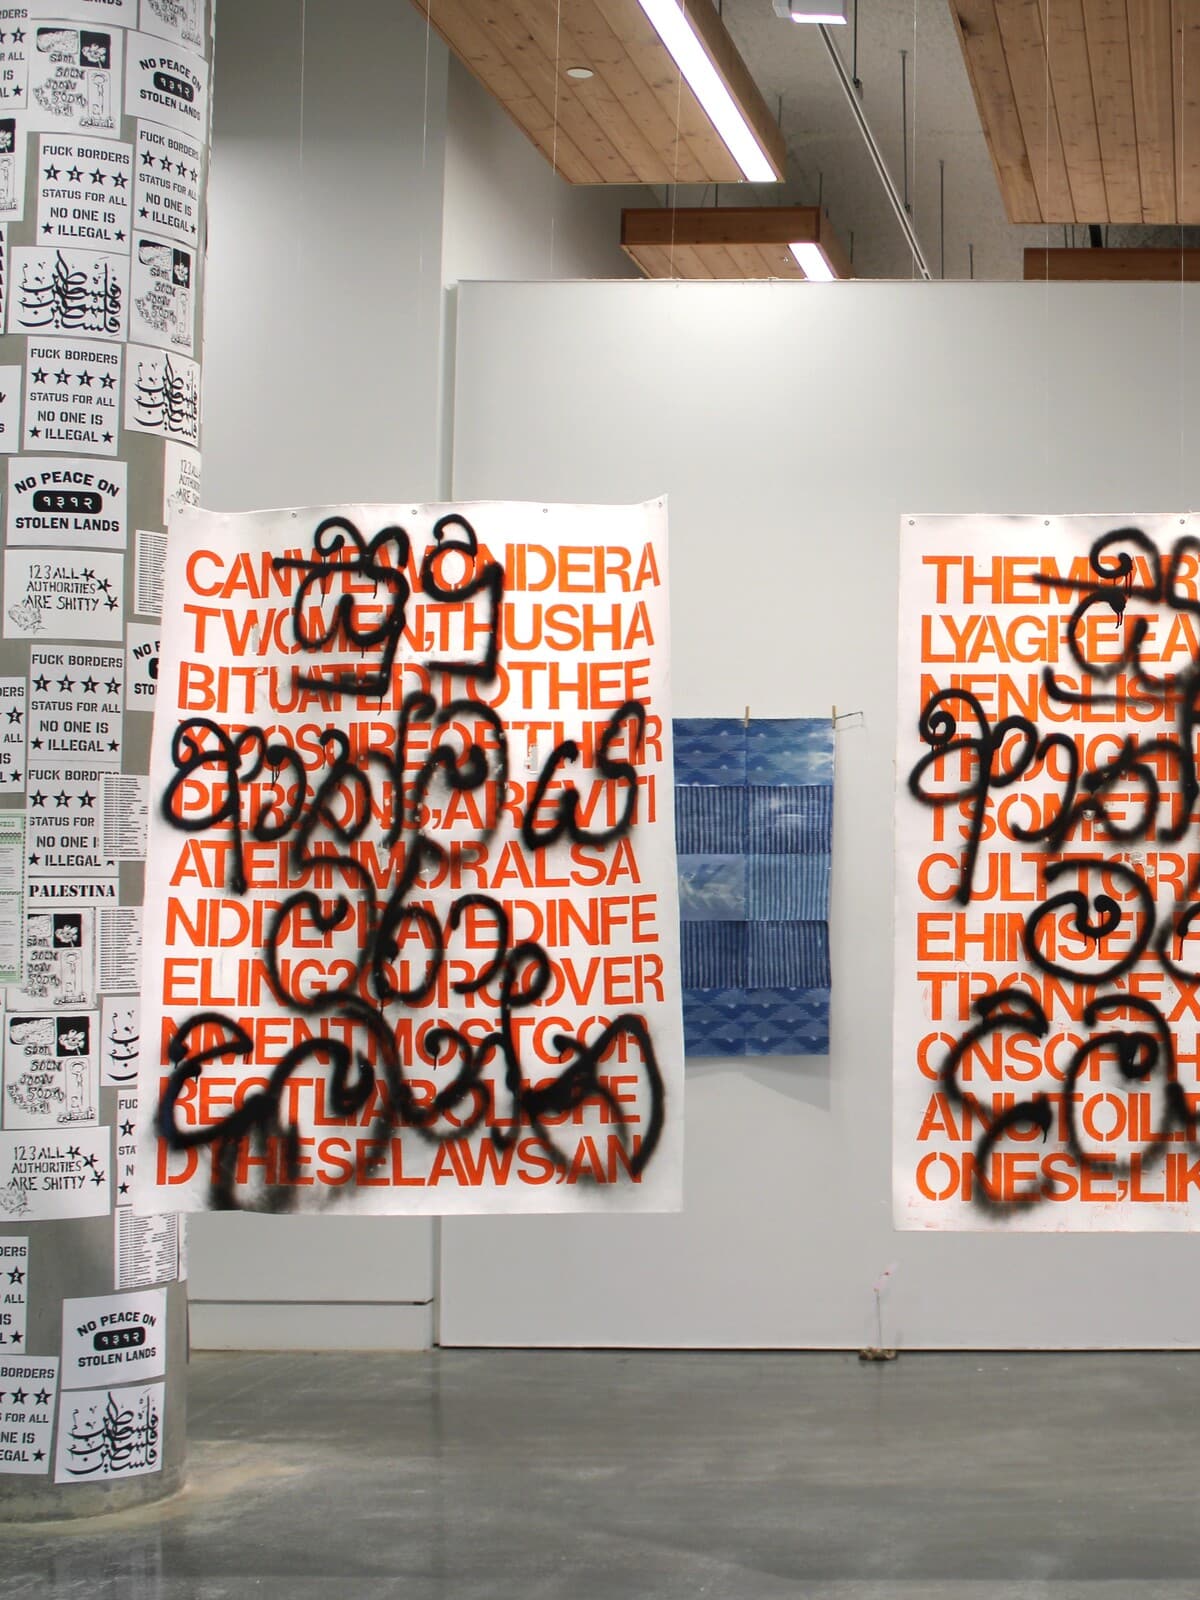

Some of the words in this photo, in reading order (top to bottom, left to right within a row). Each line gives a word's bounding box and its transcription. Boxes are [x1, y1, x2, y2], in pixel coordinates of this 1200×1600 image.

[8, 52, 24, 61] ALL
[3, 70, 14, 80] IS
[139, 58, 157, 70] NO
[159, 58, 191, 79] PEACE
[140, 89, 177, 109] STOLEN
[140, 130, 165, 146] FUCK
[43, 145, 73, 157] FUCK
[78, 148, 130, 164] BORDERS
[139, 173, 171, 190] STATUS
[173, 183, 187, 194] FOR
[42, 188, 81, 200] STATUS
[85, 191, 105, 202] FOR
[109, 195, 127, 206] ALL
[146, 192, 161, 206] NO
[164, 198, 182, 213] ONE
[184, 204, 192, 216] IS
[50, 207, 68, 219] NO
[72, 208, 99, 222] ONE
[104, 212, 116, 223] IS
[152, 211, 189, 232] ILLEGAL
[58, 225, 111, 240] ILLEGAL
[31, 348, 60, 359] FUCK
[65, 350, 118, 365] BORDERS
[30, 392, 69, 403] STATUS
[73, 394, 93, 405] FOR
[96, 397, 115, 407] ALL
[37, 410, 55, 422] NO
[60, 412, 86, 424] ONE
[91, 414, 103, 425] IS
[45, 428, 98, 442] ILLEGAL
[14, 477, 36, 494] NO
[41, 471, 94, 486] PEACE
[97, 479, 120, 497] ON
[16, 517, 69, 529] STOLEN
[74, 518, 120, 532] LANDS
[27, 581, 96, 594] AUTHORITIES
[56, 596, 99, 611] SHITTY
[133, 644, 151, 660] NO
[32, 654, 63, 665] FUCK
[68, 656, 123, 668] BORDERS
[134, 683, 157, 695] STO
[31, 701, 72, 711] STATUS
[77, 702, 98, 712] FOR
[101, 703, 121, 713] ALL
[40, 721, 58, 733] NO
[64, 721, 91, 734] ONE
[96, 722, 109, 734] IS
[4, 733, 23, 743] ALL
[48, 739, 104, 752] ILLEGAL
[28, 770, 60, 781] FUCK
[30, 816, 69, 827] STATUS
[73, 817, 95, 827] FOR
[36, 836, 55, 848] NO
[61, 836, 88, 848] ONE
[45, 855, 102, 867] ILLEGAL
[29, 884, 116, 898] PALESTINA
[119, 1099, 138, 1109] FUC
[119, 1145, 136, 1155] STA
[11, 1161, 82, 1173] AUTHORITIES
[41, 1175, 86, 1190] SHITTY
[4, 1294, 24, 1304] ALL
[77, 1320, 97, 1337] NO
[100, 1311, 140, 1326] PEACE
[143, 1313, 157, 1327] ON
[78, 1353, 122, 1367] STOLEN
[126, 1347, 156, 1362] LANDS
[1, 1367, 55, 1379] BORDERS
[5, 1413, 26, 1423] FOR
[29, 1414, 49, 1424] ALL
[22, 1432, 35, 1444] IS
